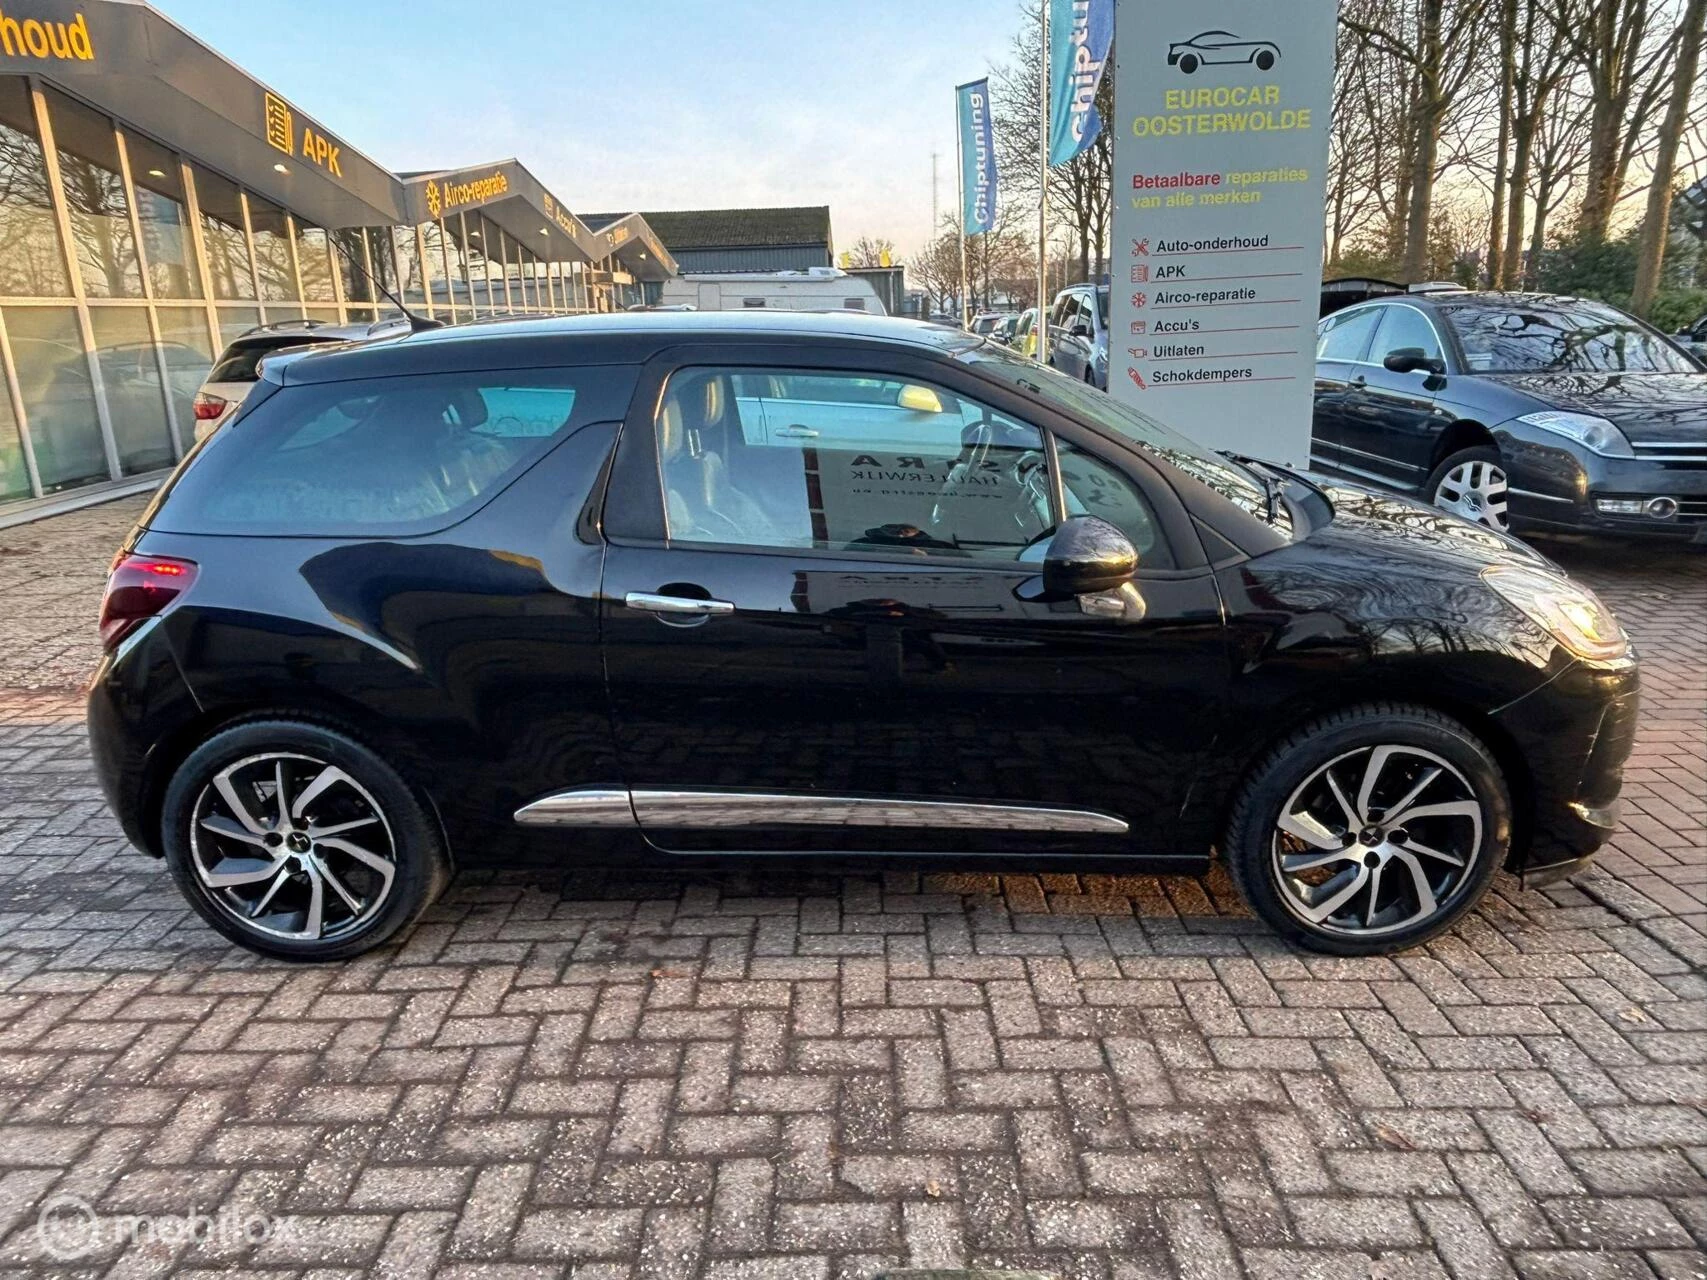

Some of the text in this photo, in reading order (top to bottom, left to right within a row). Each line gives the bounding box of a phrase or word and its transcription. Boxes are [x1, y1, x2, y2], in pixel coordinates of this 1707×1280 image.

[0, 8, 95, 60] houd
[1165, 85, 1280, 110] EUROCAR
[1132, 109, 1312, 137] OOSTERWOLDE
[303, 128, 342, 178] APK
[970, 93, 989, 224] Chiptuning
[1132, 166, 1309, 189] Betaalbare reparaties
[444, 171, 508, 210] Airco-reparatie
[1131, 190, 1261, 209] van alle merken
[1156, 235, 1269, 252] Auto-onderhoud
[1155, 265, 1186, 279] APK
[1154, 288, 1256, 304] Airco-reparatie
[1154, 319, 1200, 333] Accu's
[1153, 345, 1205, 358] Uitlaten
[1152, 368, 1253, 383] Schokdempers
